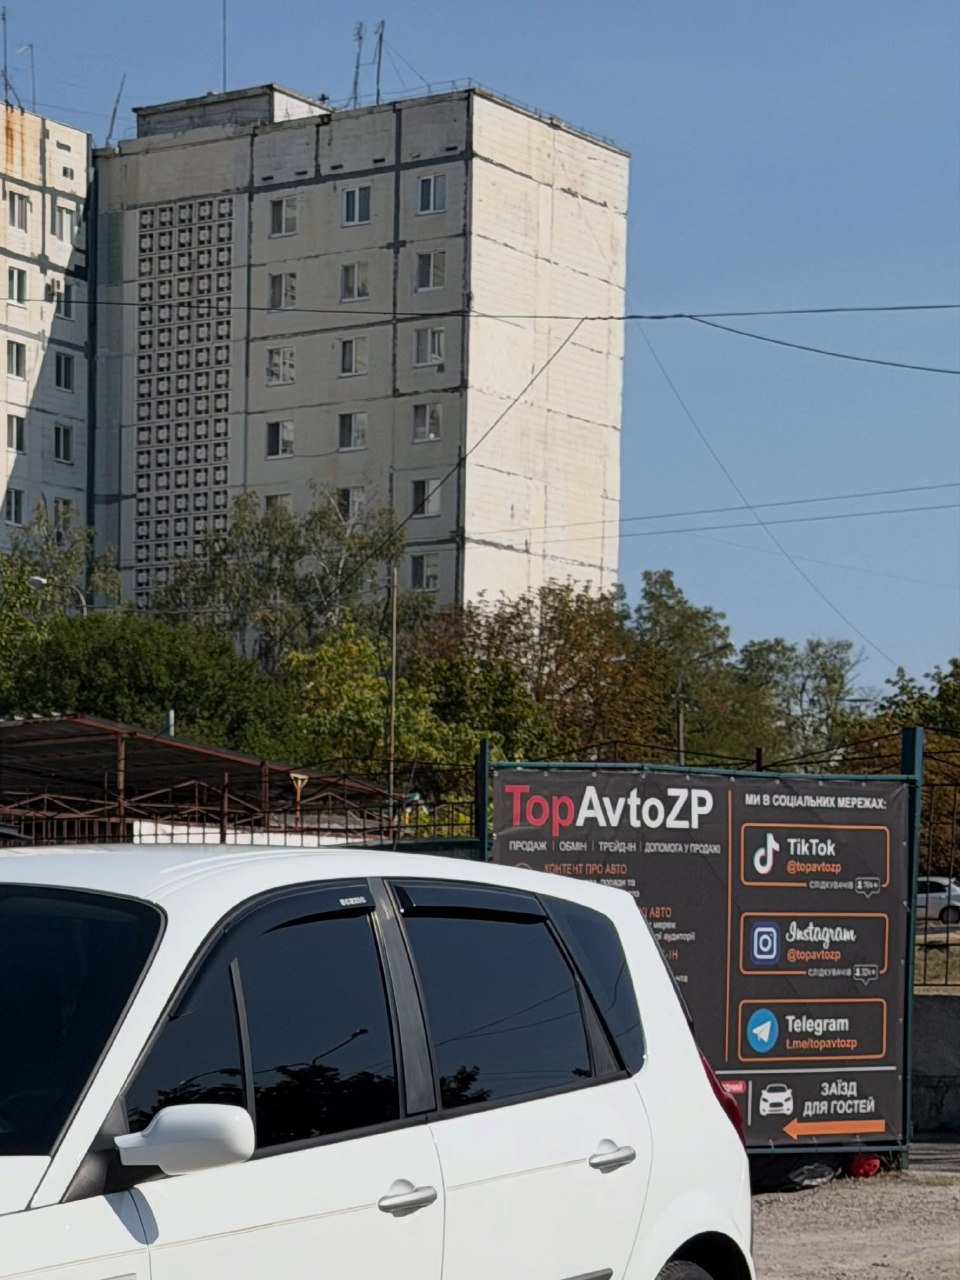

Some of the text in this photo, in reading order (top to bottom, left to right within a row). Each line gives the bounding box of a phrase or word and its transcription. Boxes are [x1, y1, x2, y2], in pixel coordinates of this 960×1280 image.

[745, 794, 887, 809] МИ В СОЦІАЛЬНИХ МЕРЕЖАХ:
[504, 784, 714, 837] TopAvtoZP
[509, 841, 547, 852] ПРОДАЖ
[559, 841, 587, 852] ОБМІН
[599, 840, 636, 852] ТРЕЙД-ІН
[644, 842, 683, 853] ДОПОМОГА
[683, 843, 689, 853] У
[787, 838, 836, 856] TikTok
[544, 864, 627, 877] КОНТЕНТ ПРО АВТО
[787, 861, 841, 874] @topavtozp
[649, 907, 672, 918] АВТО
[785, 921, 856, 949] Instagram
[787, 948, 841, 962] @topavtozp
[785, 1016, 849, 1035] Telegram
[786, 1038, 857, 1050] t.me/topavtozp
[821, 1080, 857, 1097] ЗАЇЗД
[803, 1097, 875, 1117] ДЛЯ ГОСТЕЙ
